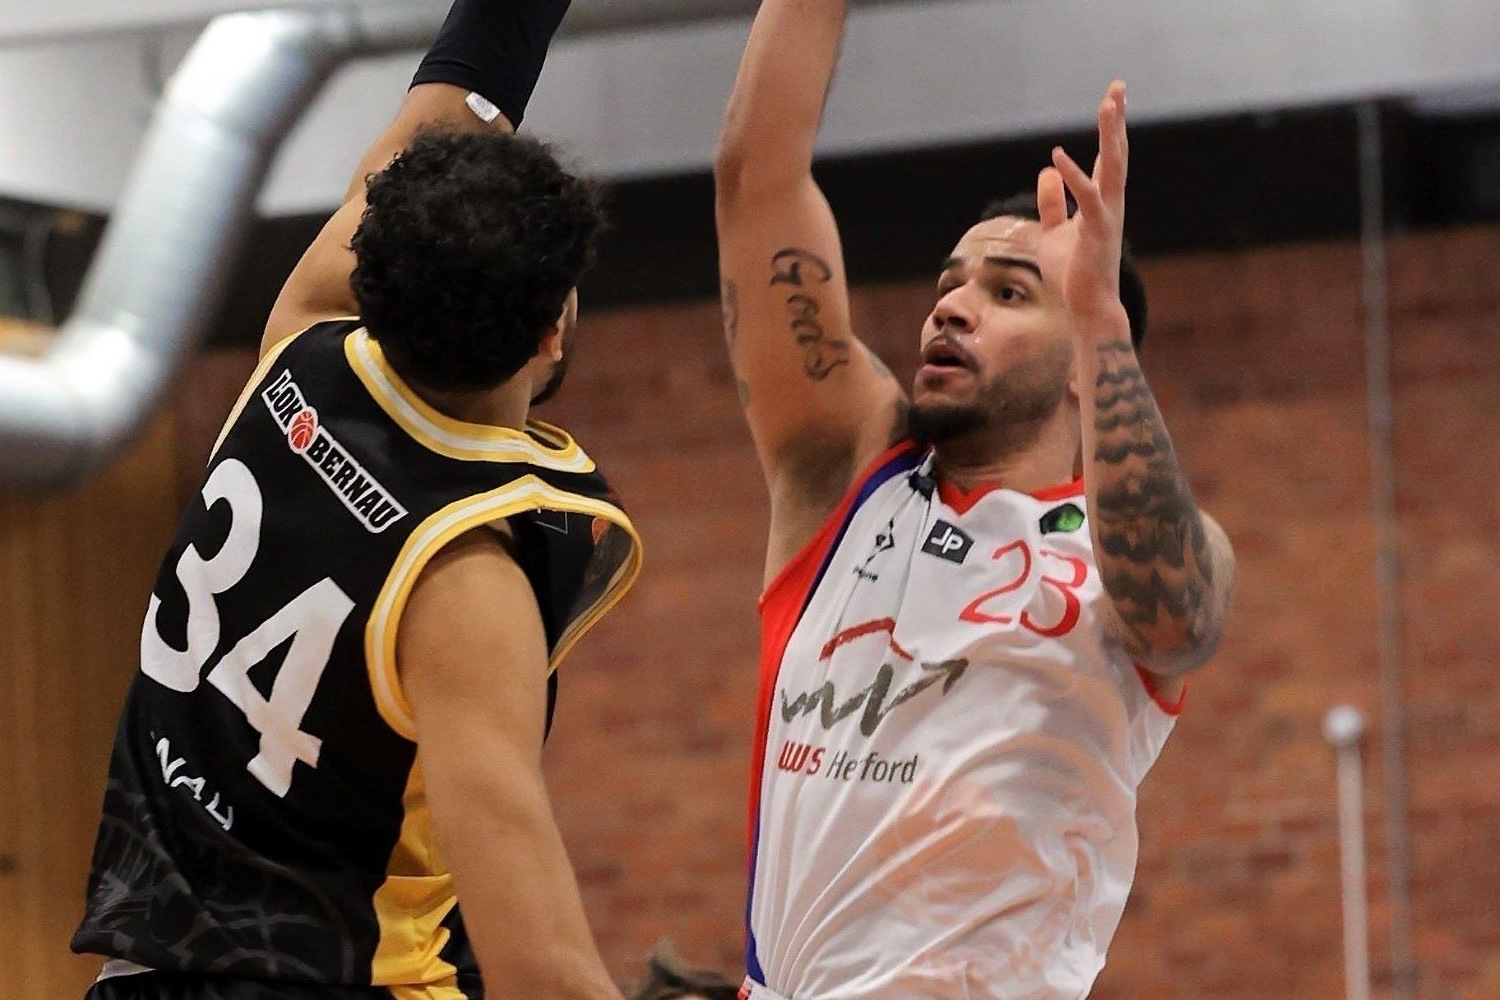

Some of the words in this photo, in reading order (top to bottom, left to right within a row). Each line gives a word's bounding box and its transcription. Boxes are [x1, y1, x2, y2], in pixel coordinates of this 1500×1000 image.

[306, 433, 400, 529] BERNAU
[140, 458, 356, 798] 34
[958, 539, 1088, 638] 23
[825, 750, 918, 784] Heford
